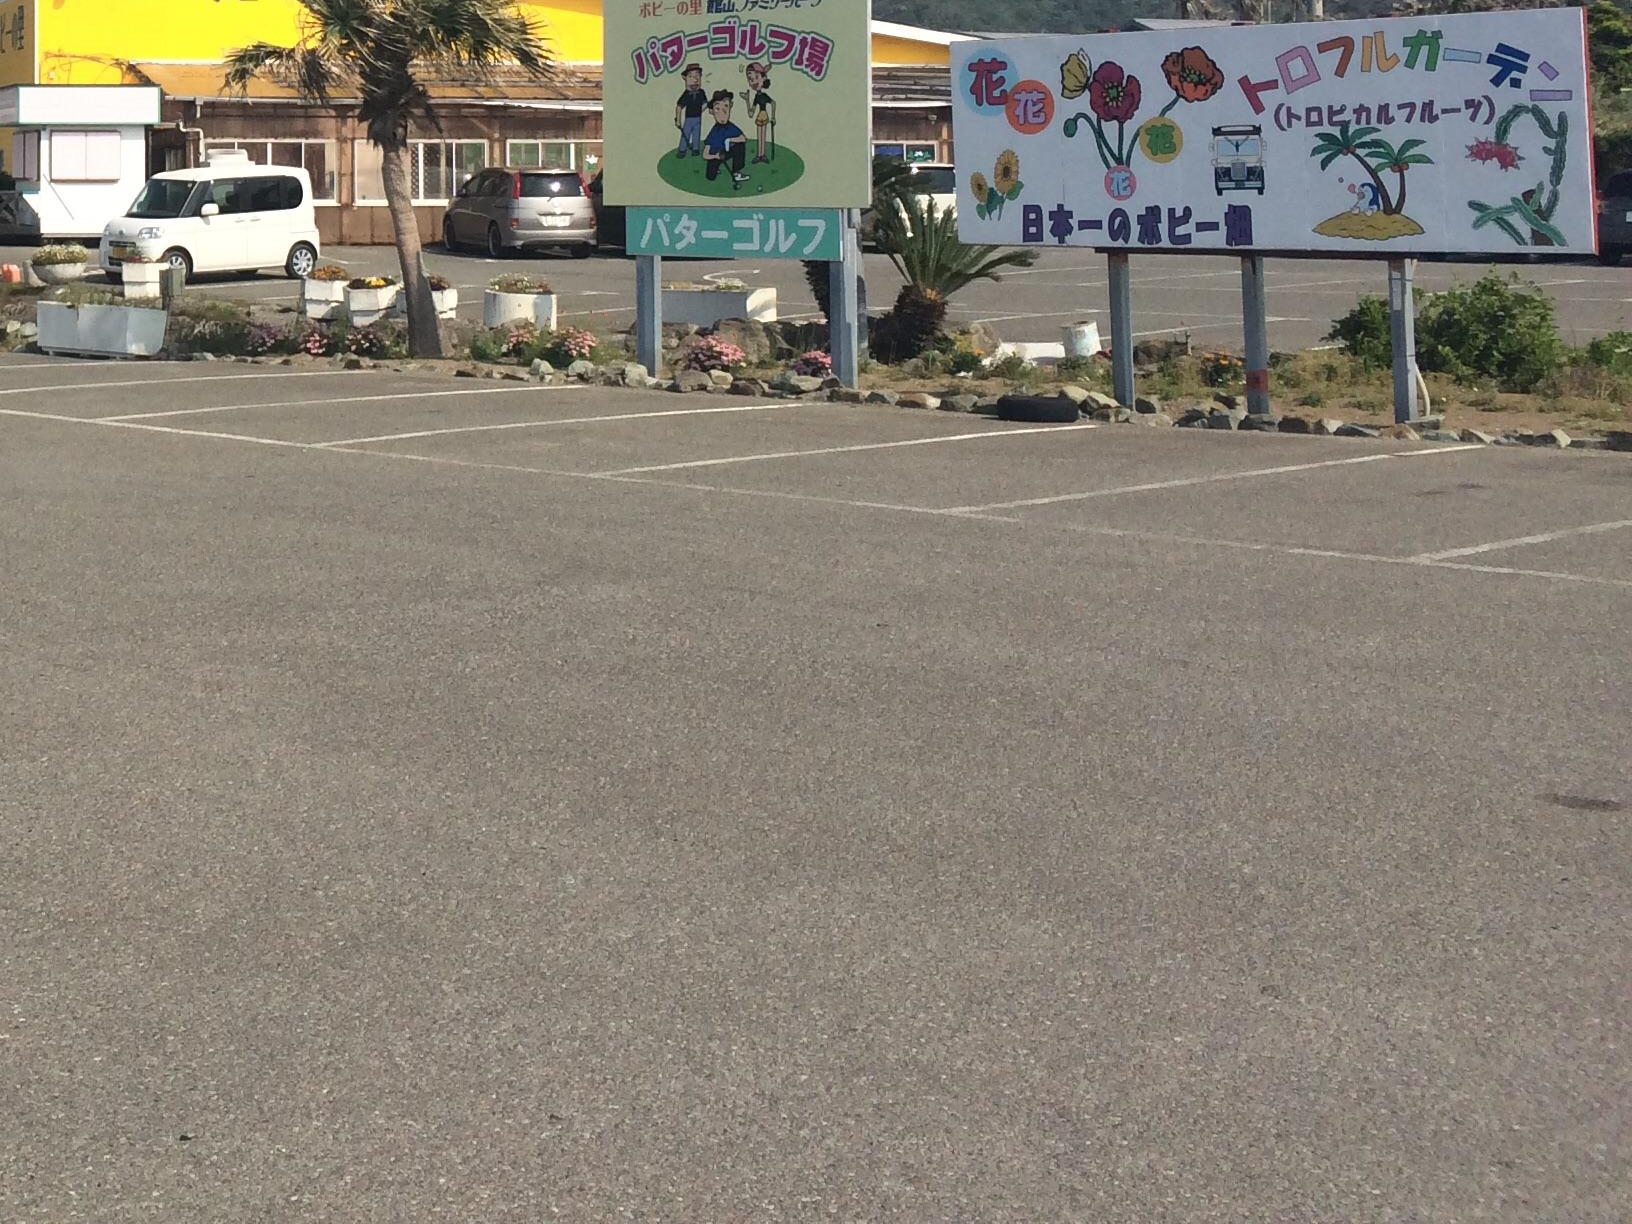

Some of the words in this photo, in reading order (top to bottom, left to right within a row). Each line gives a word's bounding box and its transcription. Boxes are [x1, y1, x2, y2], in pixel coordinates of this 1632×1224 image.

[632, 18, 833, 82] パターゴルフ場
[968, 57, 1008, 106] 花
[1237, 28, 1573, 116] トロフルガーデン
[1013, 89, 1049, 126] 花
[1145, 124, 1177, 156] 花
[1110, 171, 1134, 197] 花
[640, 213, 827, 255] パターゴルフ
[1022, 203, 1254, 247] 日本一のポピー畑
